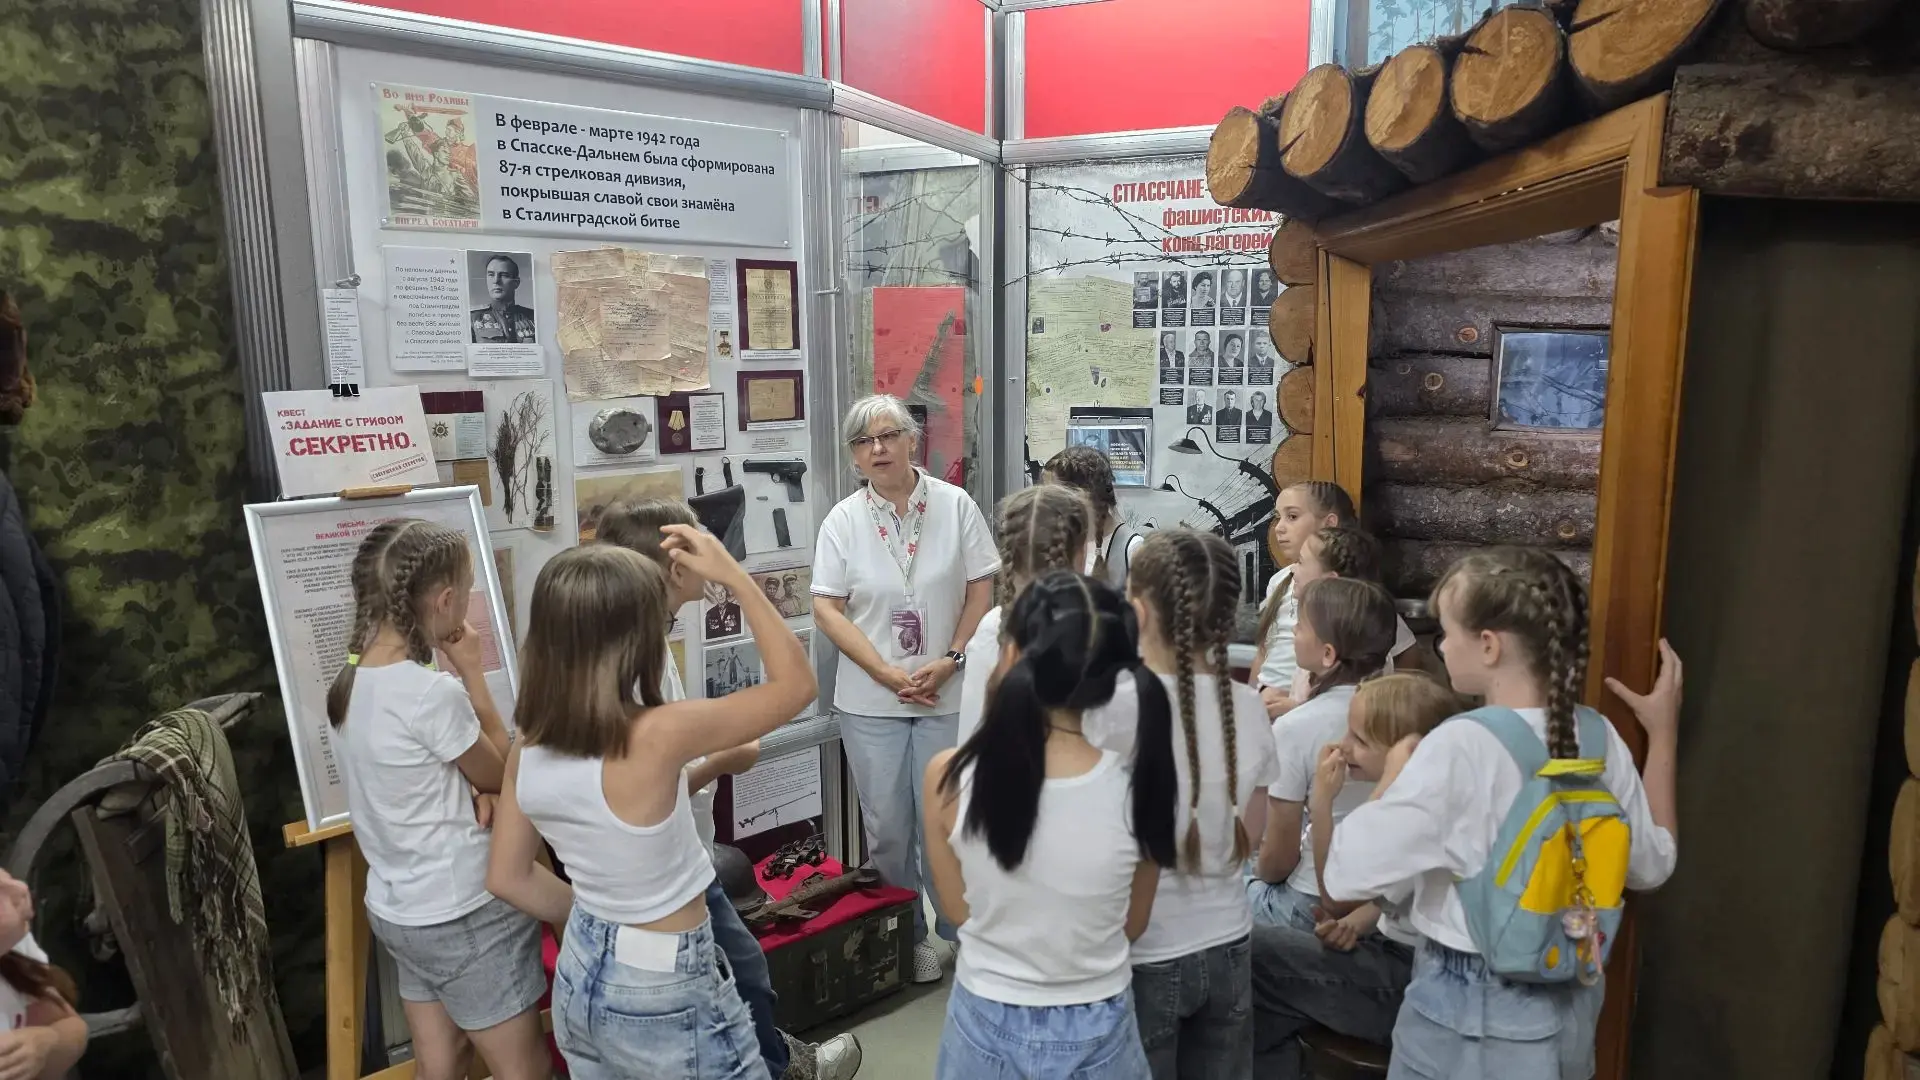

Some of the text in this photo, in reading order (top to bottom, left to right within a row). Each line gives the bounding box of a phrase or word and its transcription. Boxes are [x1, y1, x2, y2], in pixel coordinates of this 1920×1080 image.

[495, 113, 506, 127] В
[510, 115, 578, 136] феврале
[589, 125, 634, 144] марте
[637, 131, 666, 146] 1942
[670, 134, 700, 149] года
[497, 138, 775, 176] в Спасске-Дальнем была сформирована
[499, 160, 686, 190] 87-я стрелковая дивизия,
[500, 185, 735, 212] покрывшая славой свои знамёна
[502, 207, 680, 229] в Сталинградской битве
[1162, 207, 1273, 229] фашистских
[1161, 228, 1273, 253] концлагерей
[277, 408, 306, 417] КВЕСТ
[280, 415, 404, 430] «ЗАДАНИЕ С ГРИФОМ
